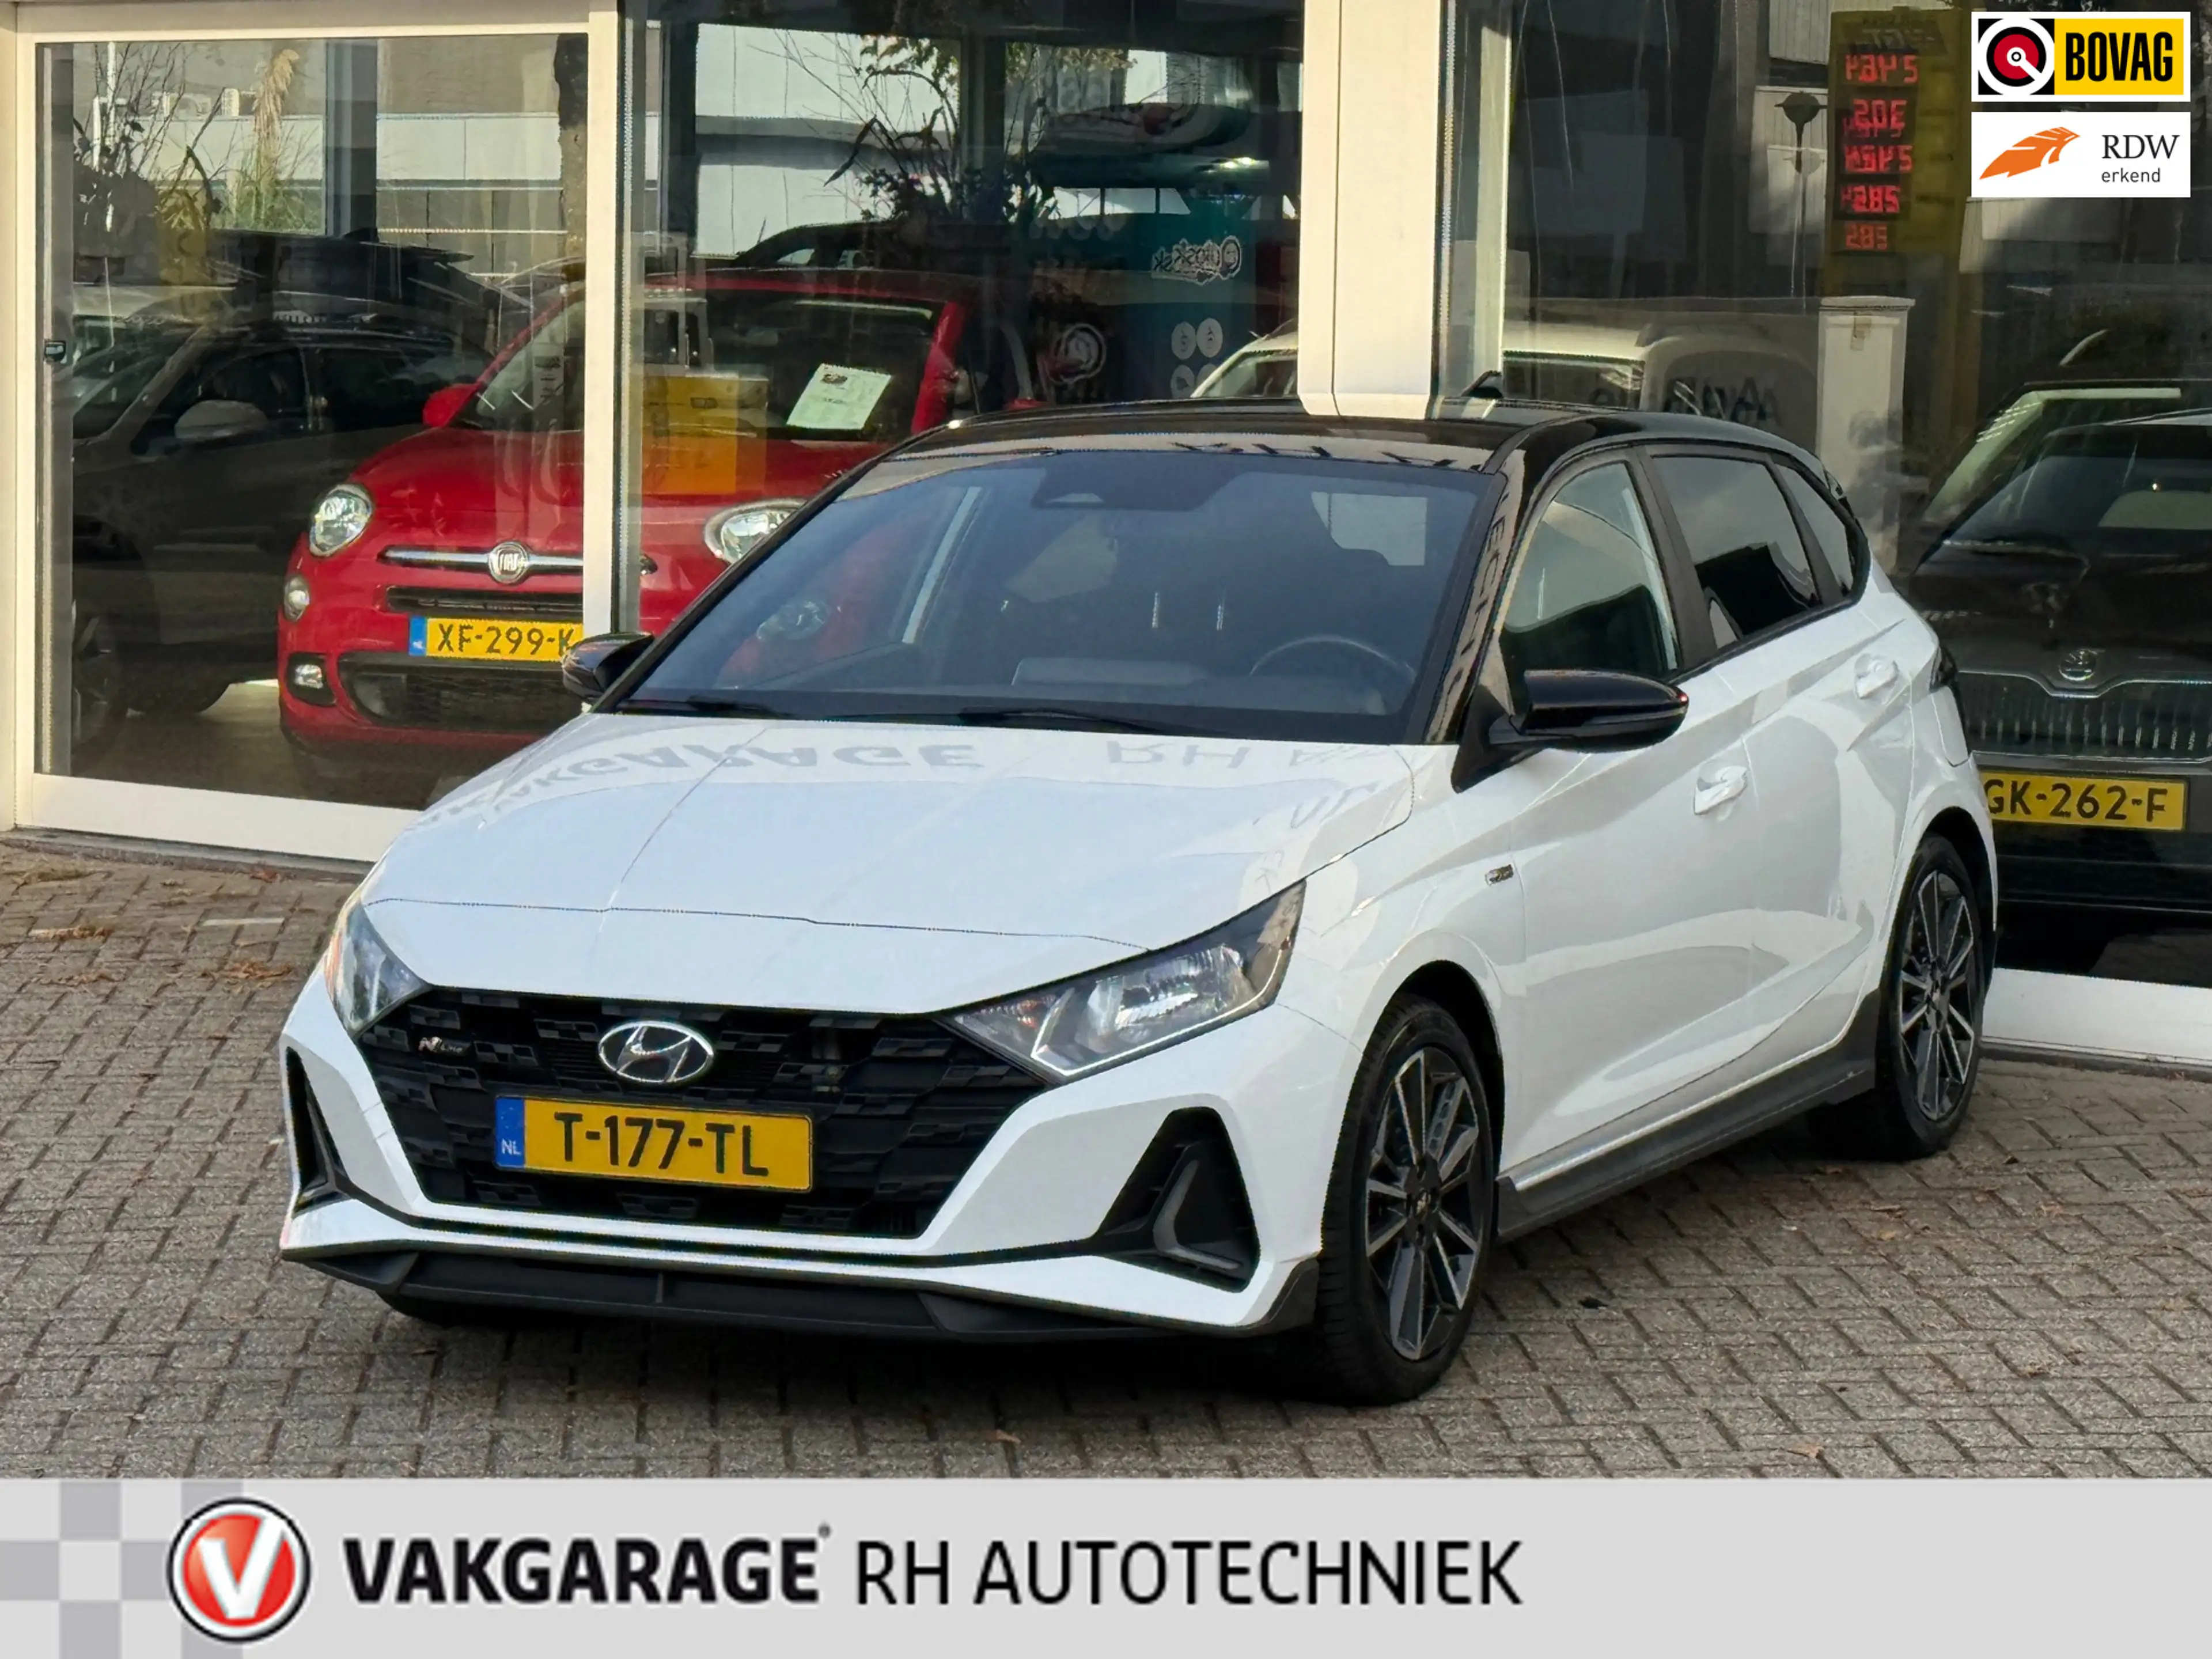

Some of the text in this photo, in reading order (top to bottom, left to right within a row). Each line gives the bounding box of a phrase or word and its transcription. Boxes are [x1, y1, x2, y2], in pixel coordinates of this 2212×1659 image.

[437, 623, 574, 656] XF-299-K
[1984, 779, 2168, 823] GK-262-F
[501, 1139, 521, 1156] NL
[554, 1112, 769, 1176] T-177-TL
